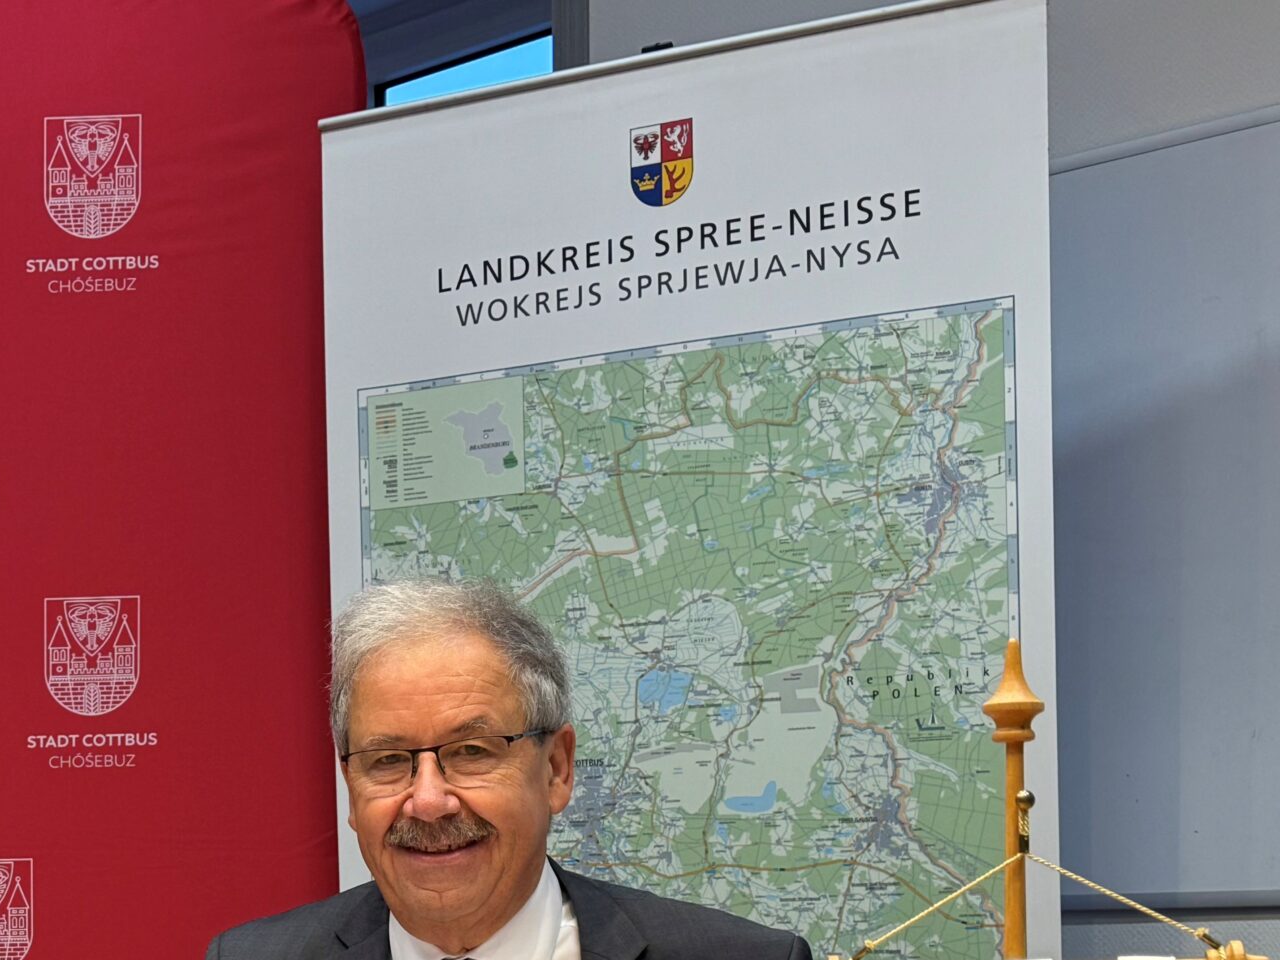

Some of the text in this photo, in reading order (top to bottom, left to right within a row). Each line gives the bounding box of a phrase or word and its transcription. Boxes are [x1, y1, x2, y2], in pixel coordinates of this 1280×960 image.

[437, 188, 922, 294] LANDKREIS SPREE-NEISSE
[26, 254, 160, 273] STADT COTTBUS
[455, 236, 901, 327] WOKREJS SPRJEWJA-NYSA
[846, 665, 990, 686] Republik
[872, 684, 963, 701] POLEN
[27, 732, 158, 749] STADT COTTBUS
